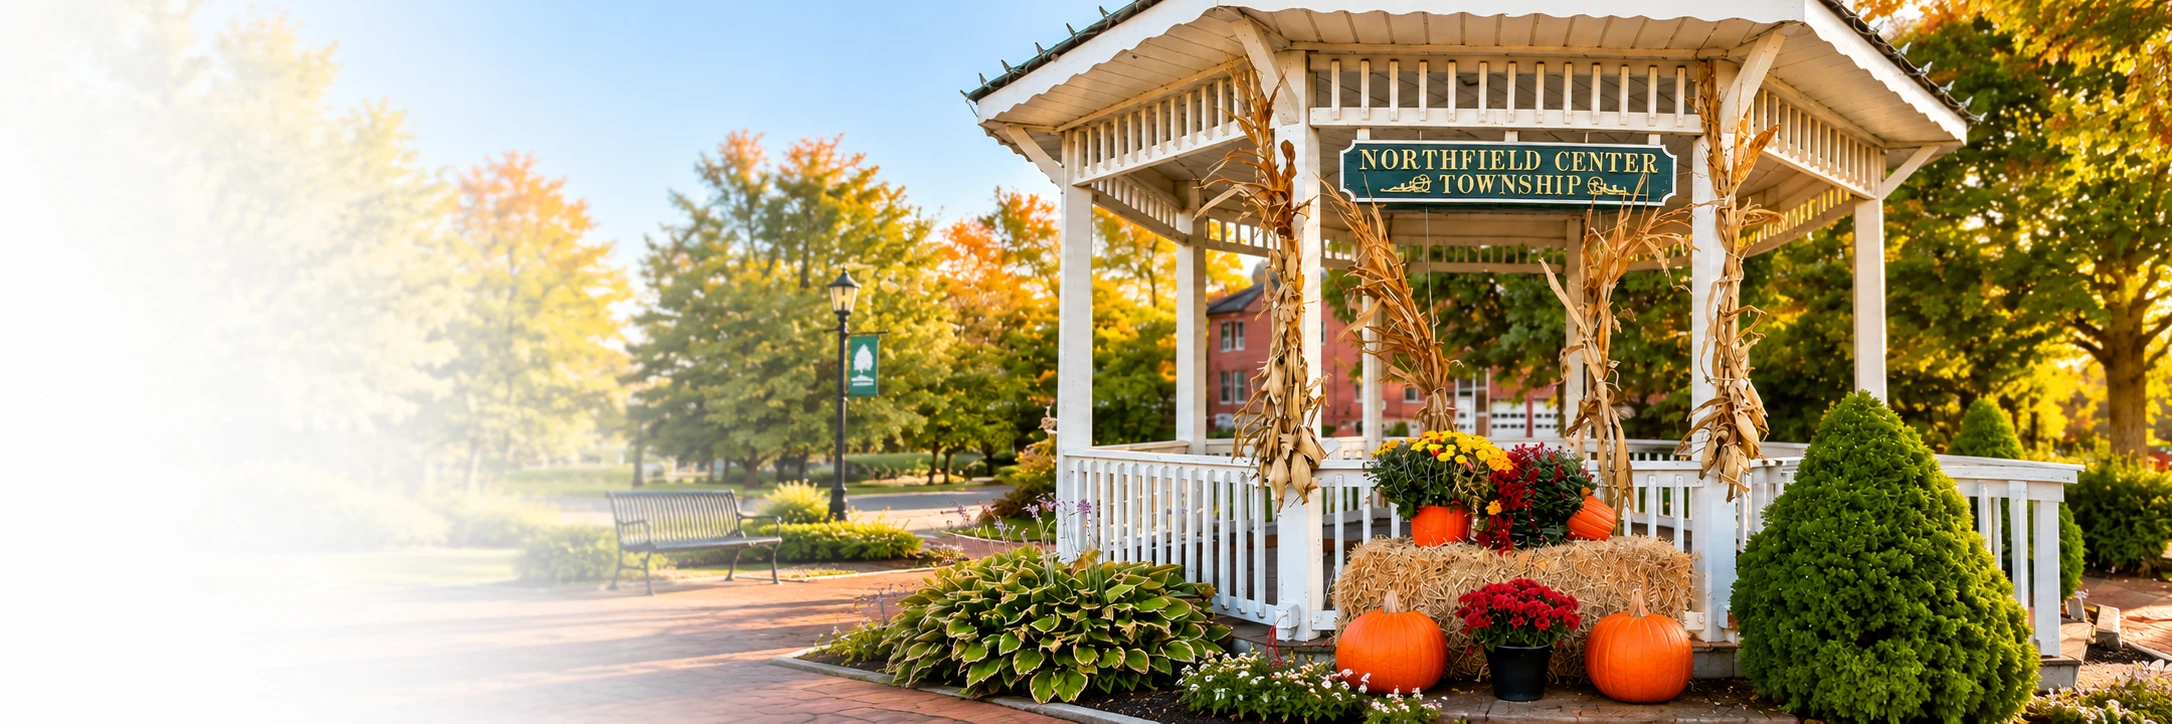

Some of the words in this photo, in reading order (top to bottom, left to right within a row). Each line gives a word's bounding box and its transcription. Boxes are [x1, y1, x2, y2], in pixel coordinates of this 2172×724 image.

[1359, 149, 1542, 171] NORTHFIELD
[1554, 151, 1659, 174] CENTER
[1439, 174, 1582, 195] TOWNSHIP
